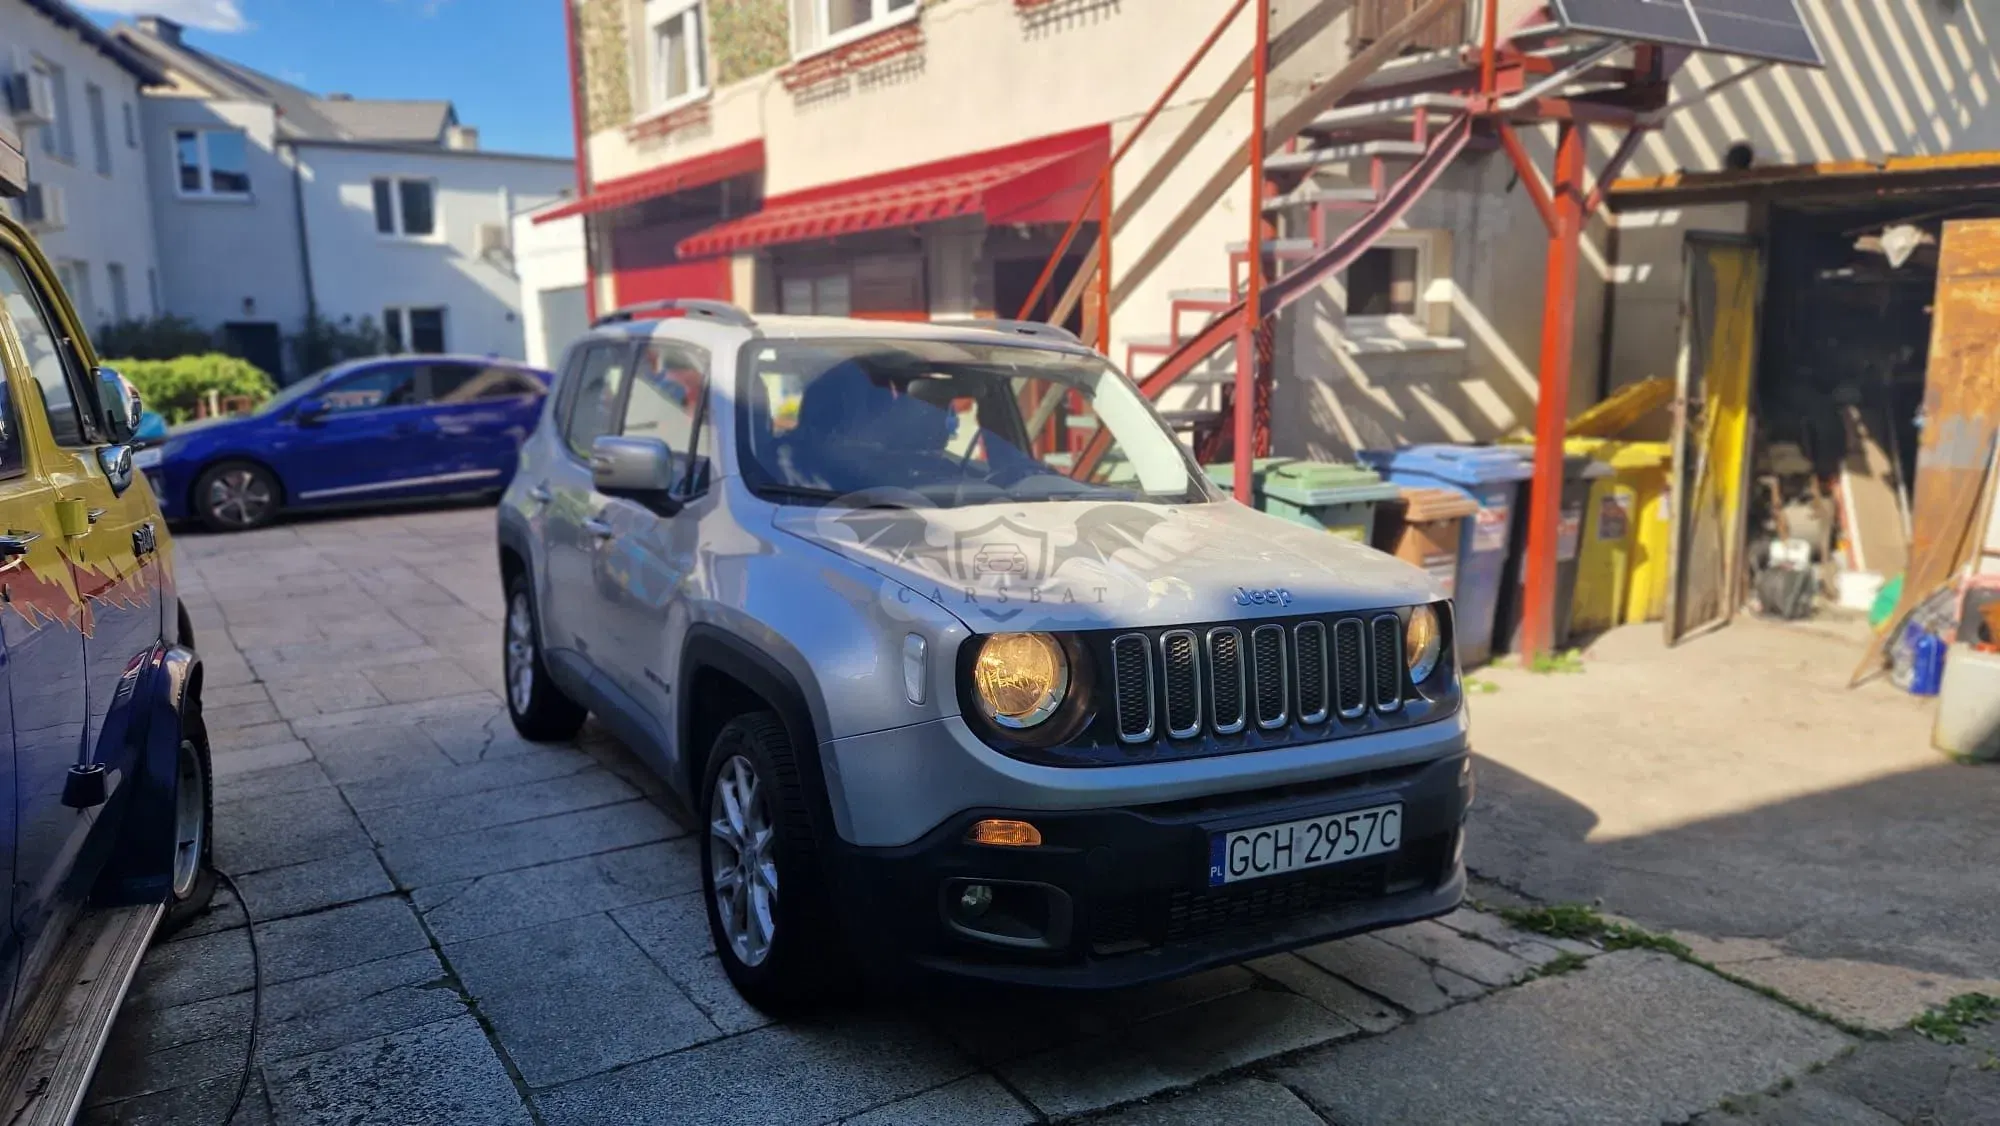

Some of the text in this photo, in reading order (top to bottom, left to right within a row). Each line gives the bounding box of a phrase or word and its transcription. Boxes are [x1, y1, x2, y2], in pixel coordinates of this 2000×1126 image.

[1232, 586, 1293, 608] Jeep
[1228, 809, 1399, 877] GCH 2957C
[1210, 865, 1223, 878] PL
